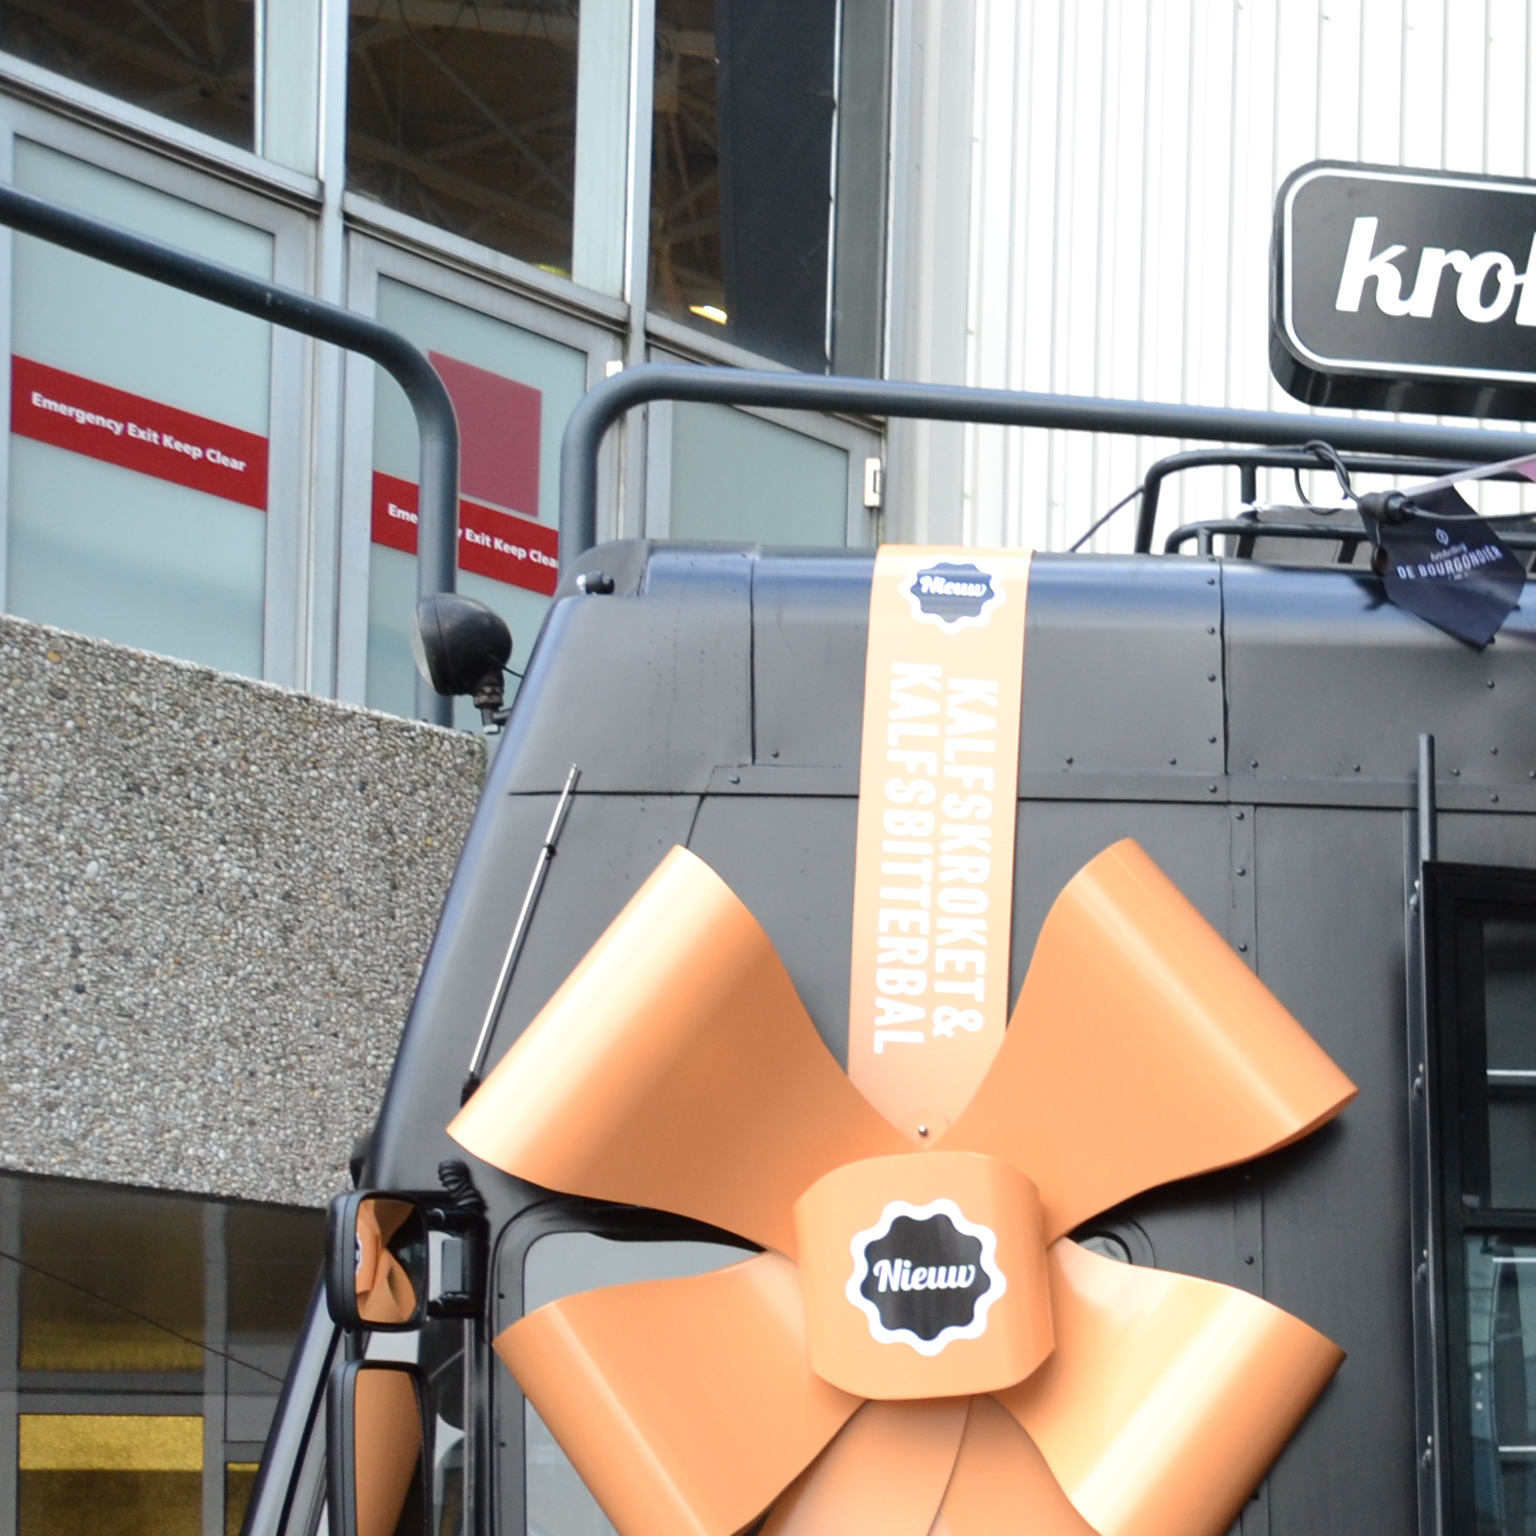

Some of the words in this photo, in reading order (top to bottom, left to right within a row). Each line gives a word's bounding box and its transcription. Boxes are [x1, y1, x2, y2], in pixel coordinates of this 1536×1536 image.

[31, 390, 124, 436] Emergency
[127, 421, 160, 445] Exit
[162, 433, 203, 461] Keep
[206, 447, 247, 472] Clear
[465, 527, 491, 549] Exit
[494, 536, 526, 561] Keep
[529, 548, 559, 569] Clea
[918, 573, 987, 599] Nieuw
[1396, 564, 1415, 580] DE
[934, 676, 999, 997] KALFSKROKET
[873, 661, 943, 1056] KALFSBITTERBAL
[931, 1004, 985, 1039] &
[872, 1257, 977, 1294] Nieuw
